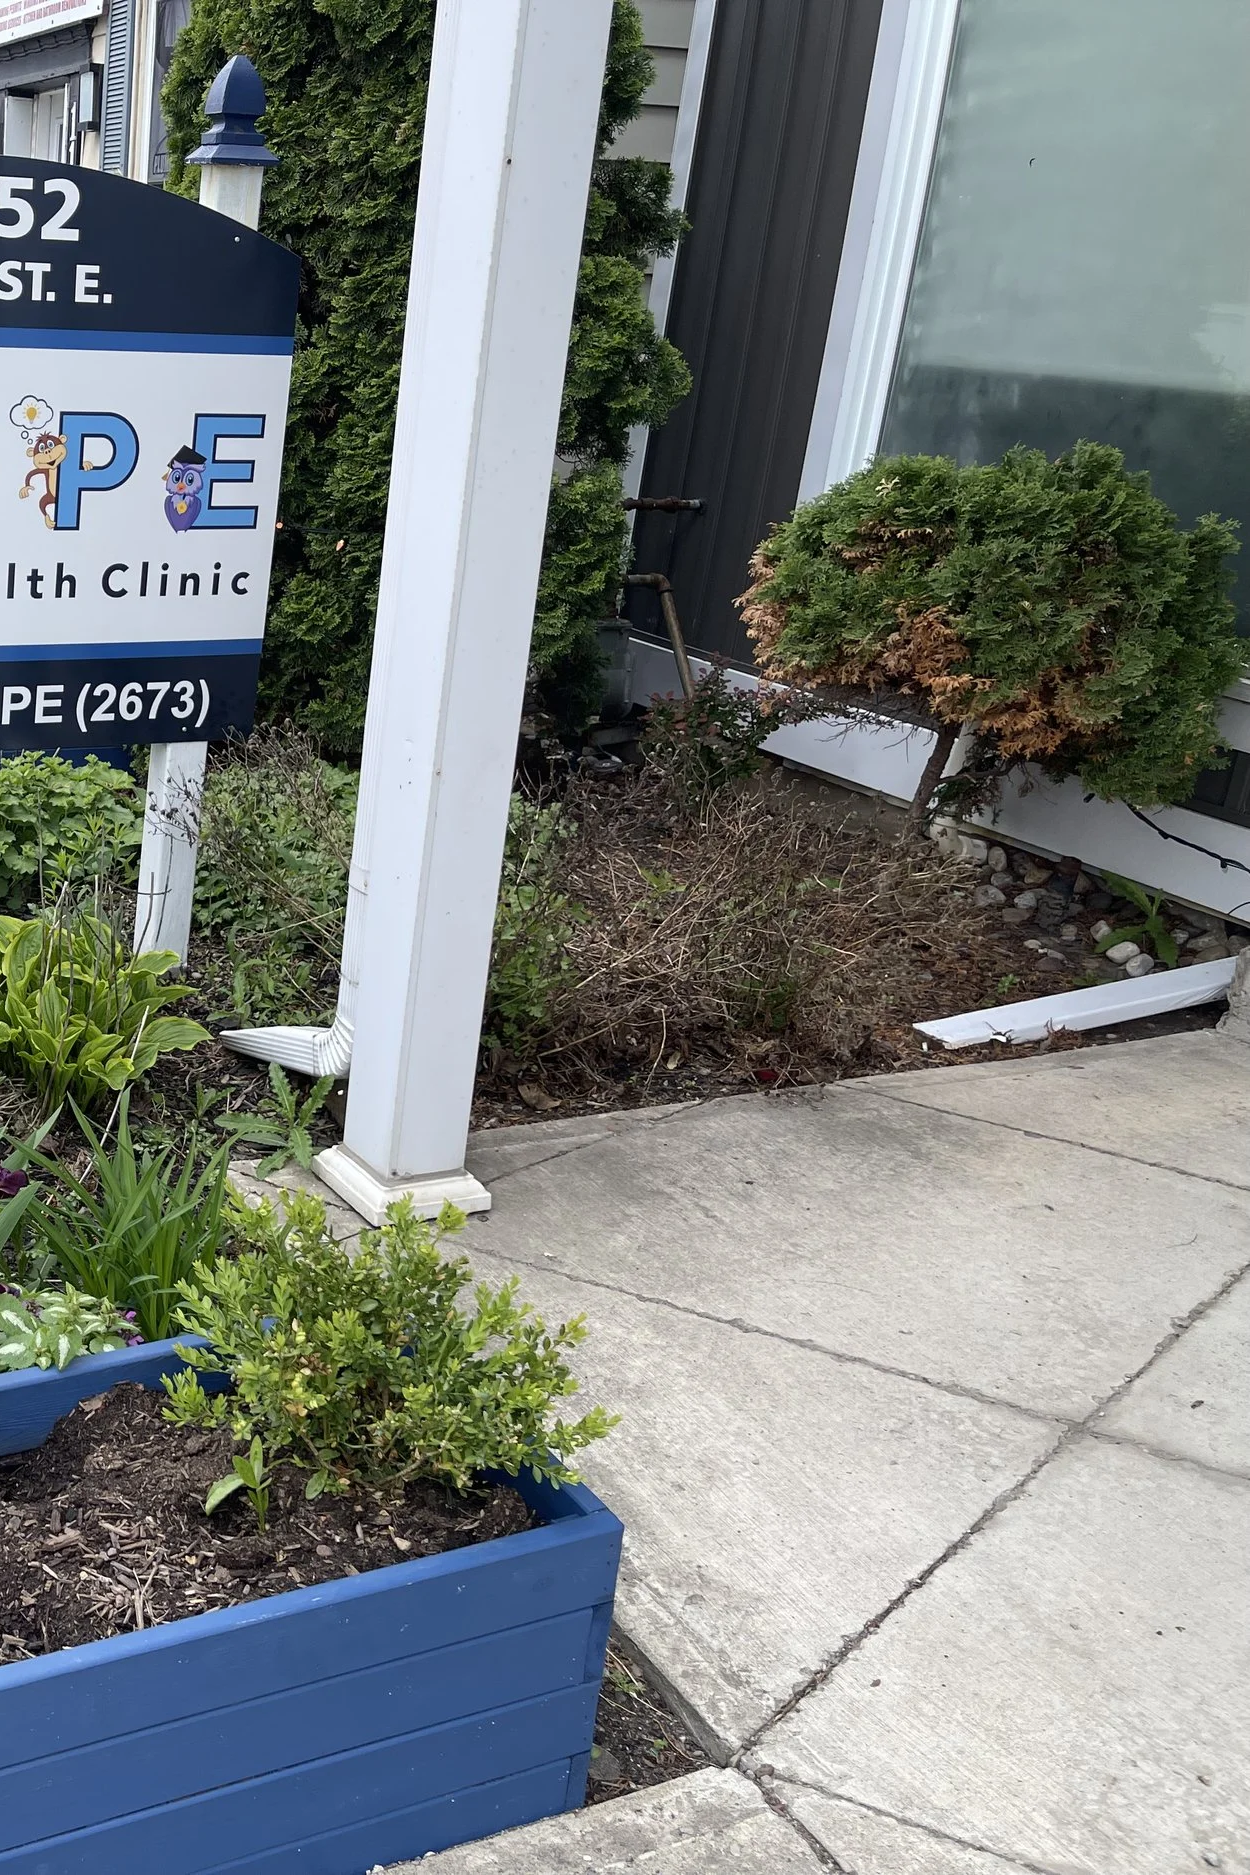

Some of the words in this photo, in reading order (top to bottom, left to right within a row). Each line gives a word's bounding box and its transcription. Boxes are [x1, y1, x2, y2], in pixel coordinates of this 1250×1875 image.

[74, 264, 113, 304] E.
[101, 561, 250, 599] Clinic
[76, 679, 211, 734] (2673)
